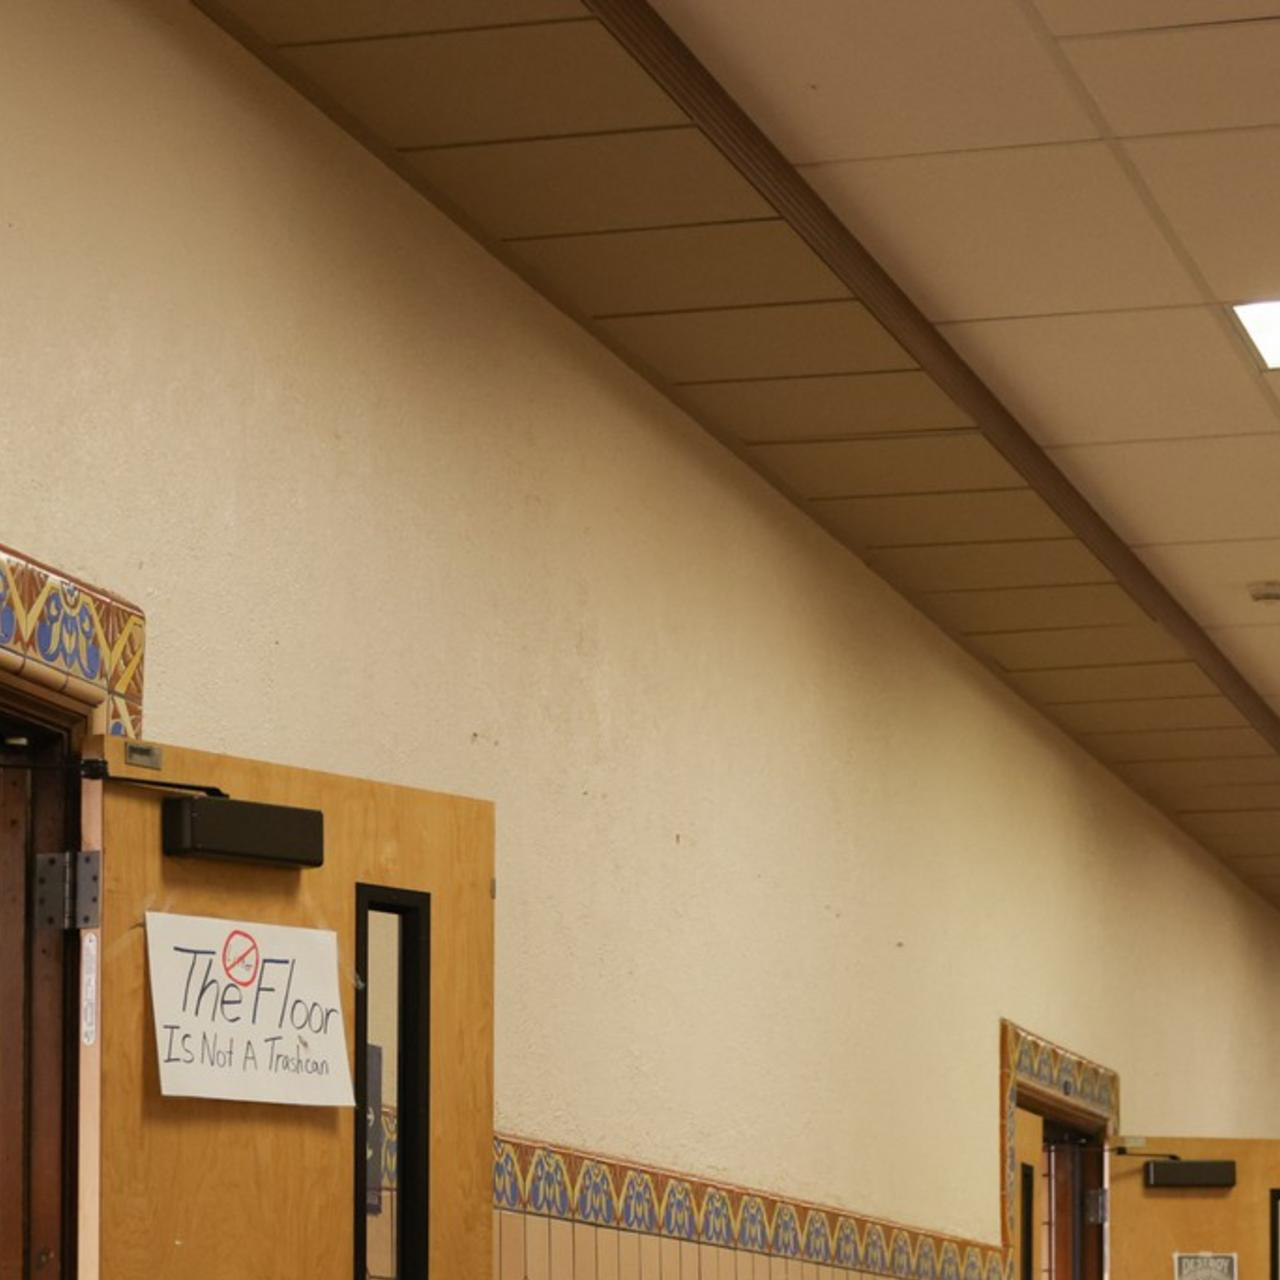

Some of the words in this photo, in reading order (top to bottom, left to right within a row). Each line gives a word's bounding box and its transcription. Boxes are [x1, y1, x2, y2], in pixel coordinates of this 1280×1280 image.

[173, 946, 243, 1023] The
[252, 958, 339, 1034] Floor
[201, 1032, 233, 1067] Not
[243, 1040, 258, 1073] A
[265, 1036, 330, 1075] Trashcan
[1183, 1258, 1230, 1275] DESTROY
